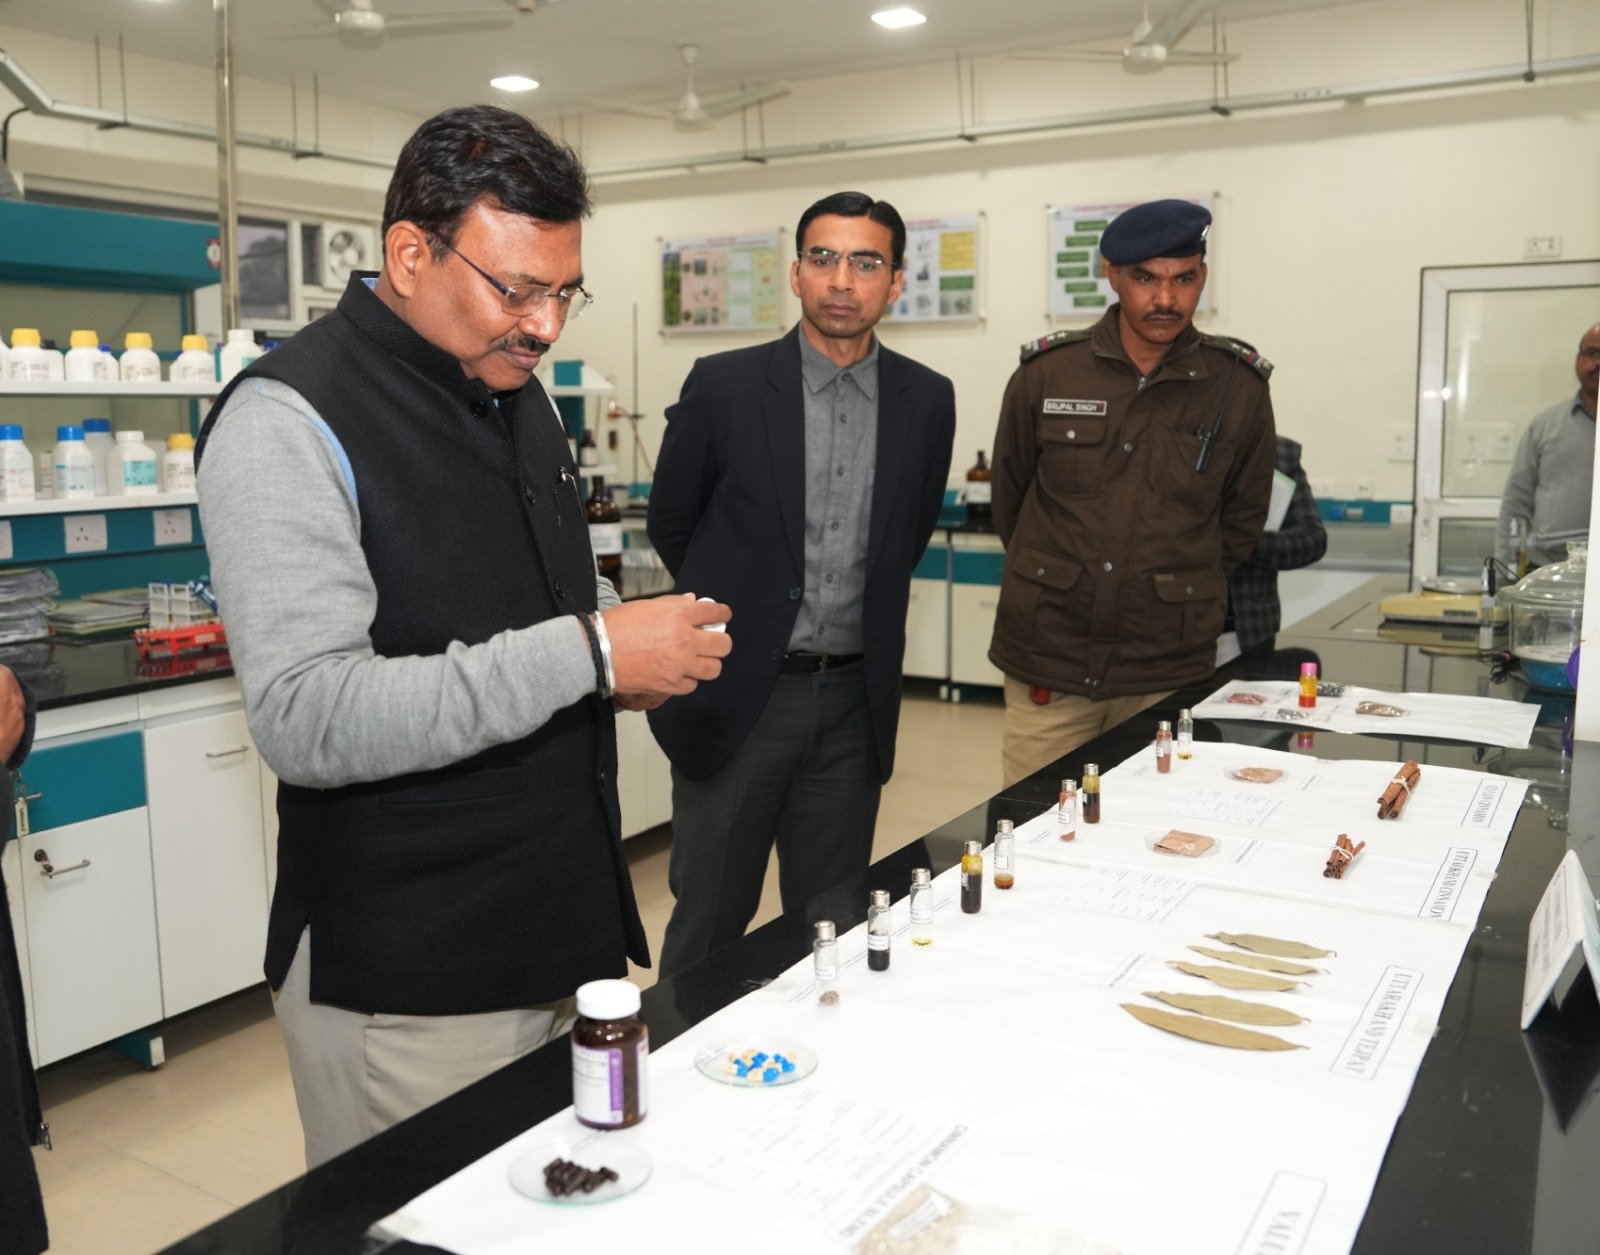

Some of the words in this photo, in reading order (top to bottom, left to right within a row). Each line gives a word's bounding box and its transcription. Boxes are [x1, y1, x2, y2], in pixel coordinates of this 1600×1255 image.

[1075, 402, 1097, 412] SINGH
[1344, 1038, 1380, 1074] TEJPAT
[918, 1123, 969, 1168] CINNAMON
